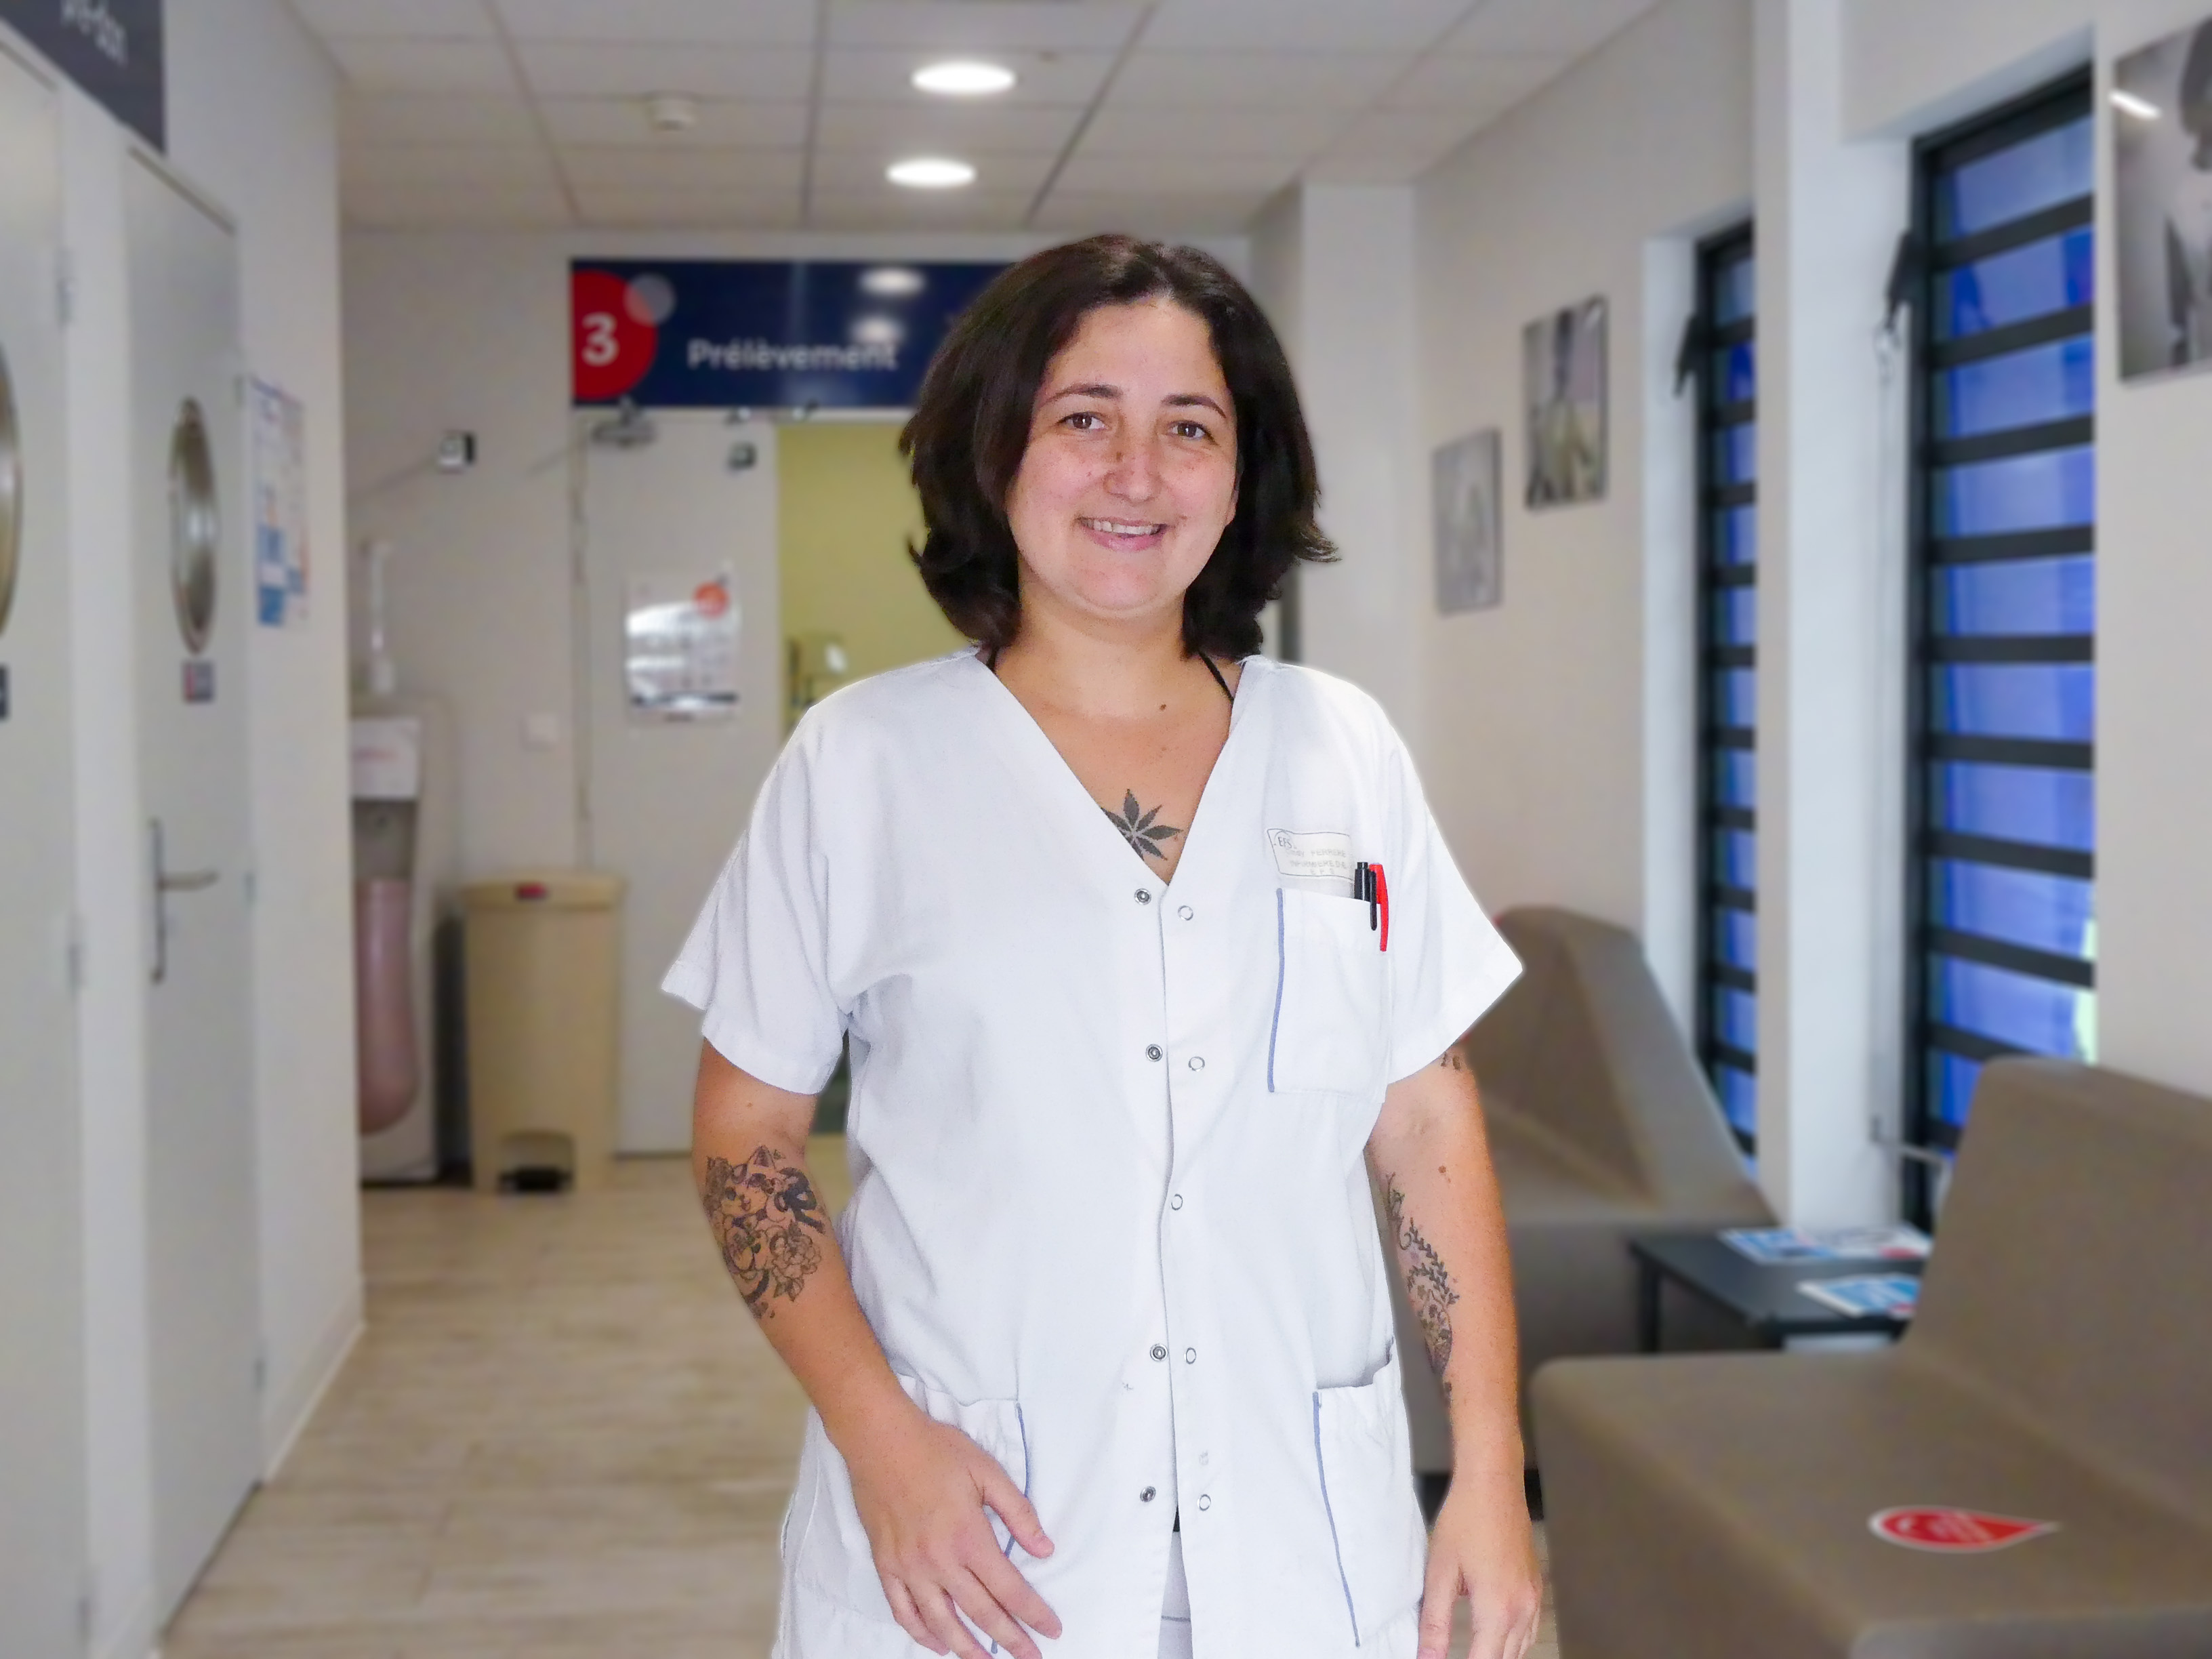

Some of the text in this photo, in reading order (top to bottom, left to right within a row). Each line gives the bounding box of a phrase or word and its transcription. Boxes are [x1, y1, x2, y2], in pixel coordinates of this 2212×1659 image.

[581, 312, 618, 366] 3
[687, 337, 899, 371] Prélèvement
[1277, 836, 1292, 848] EFS
